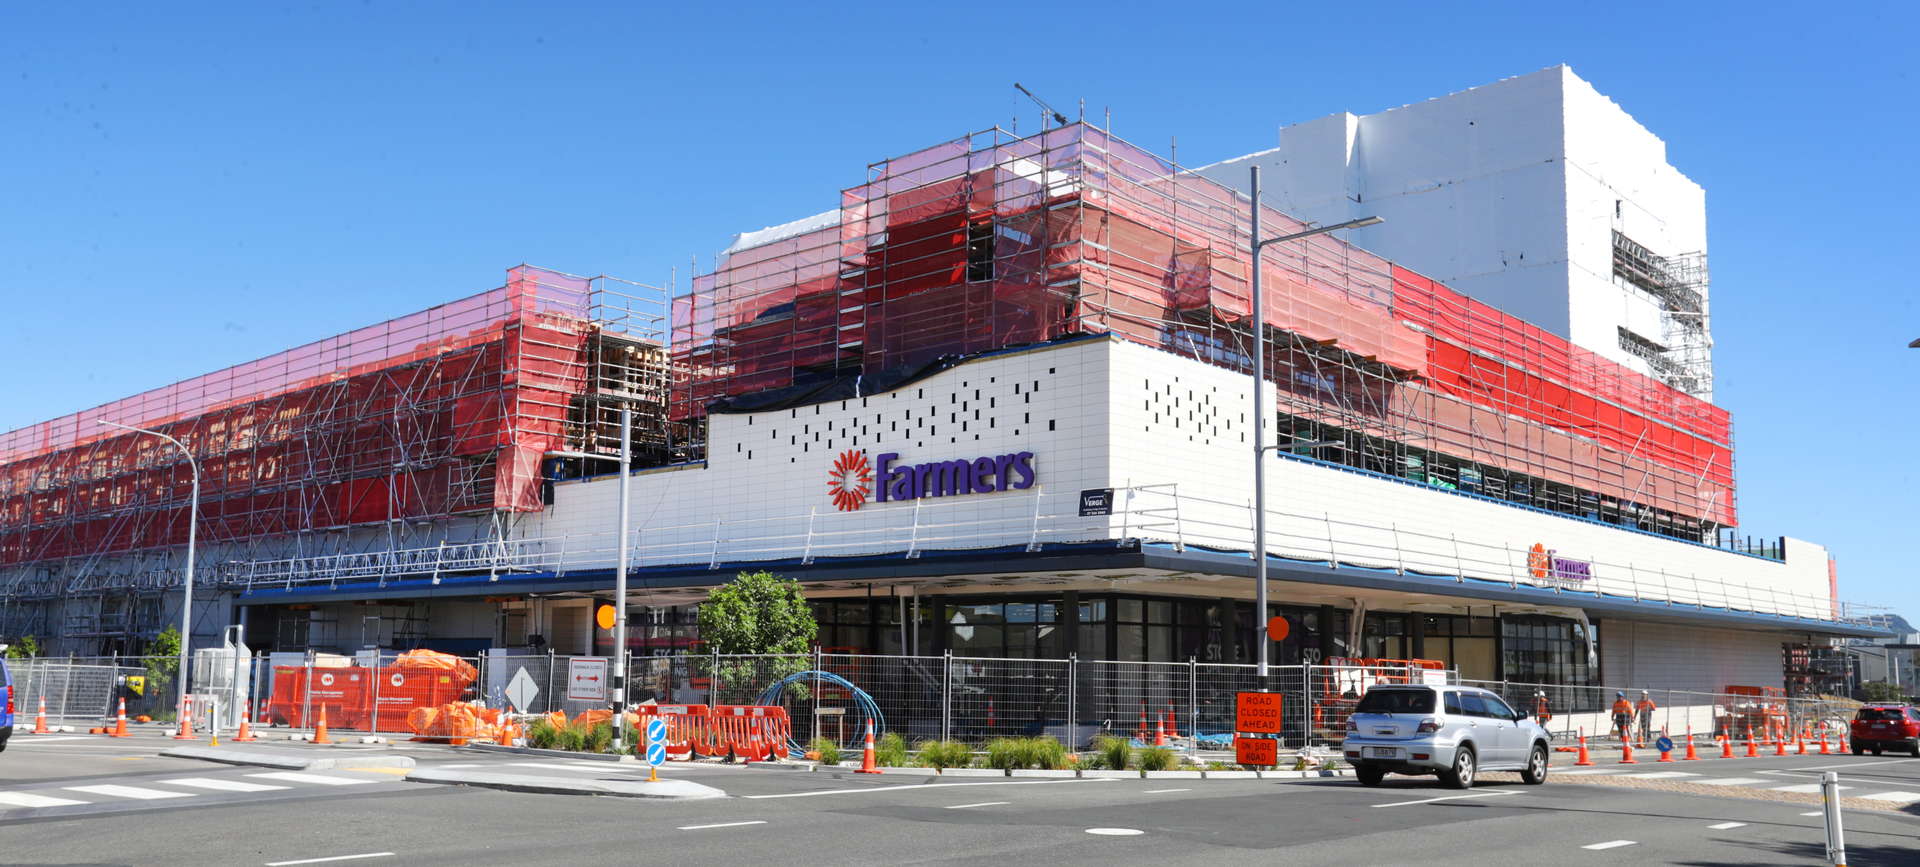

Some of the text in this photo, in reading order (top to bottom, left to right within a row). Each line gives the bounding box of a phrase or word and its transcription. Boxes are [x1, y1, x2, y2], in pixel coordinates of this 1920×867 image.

[876, 451, 1035, 503] Farmers
[1084, 496, 1104, 506] VERGE
[1547, 549, 1591, 581] Farmers
[1246, 697, 1272, 705] ROAD
[1241, 708, 1277, 717] CLOSED
[1242, 720, 1275, 729] AHEAD
[1241, 741, 1271, 751] ON SIDE
[1246, 752, 1266, 761] ROAD
